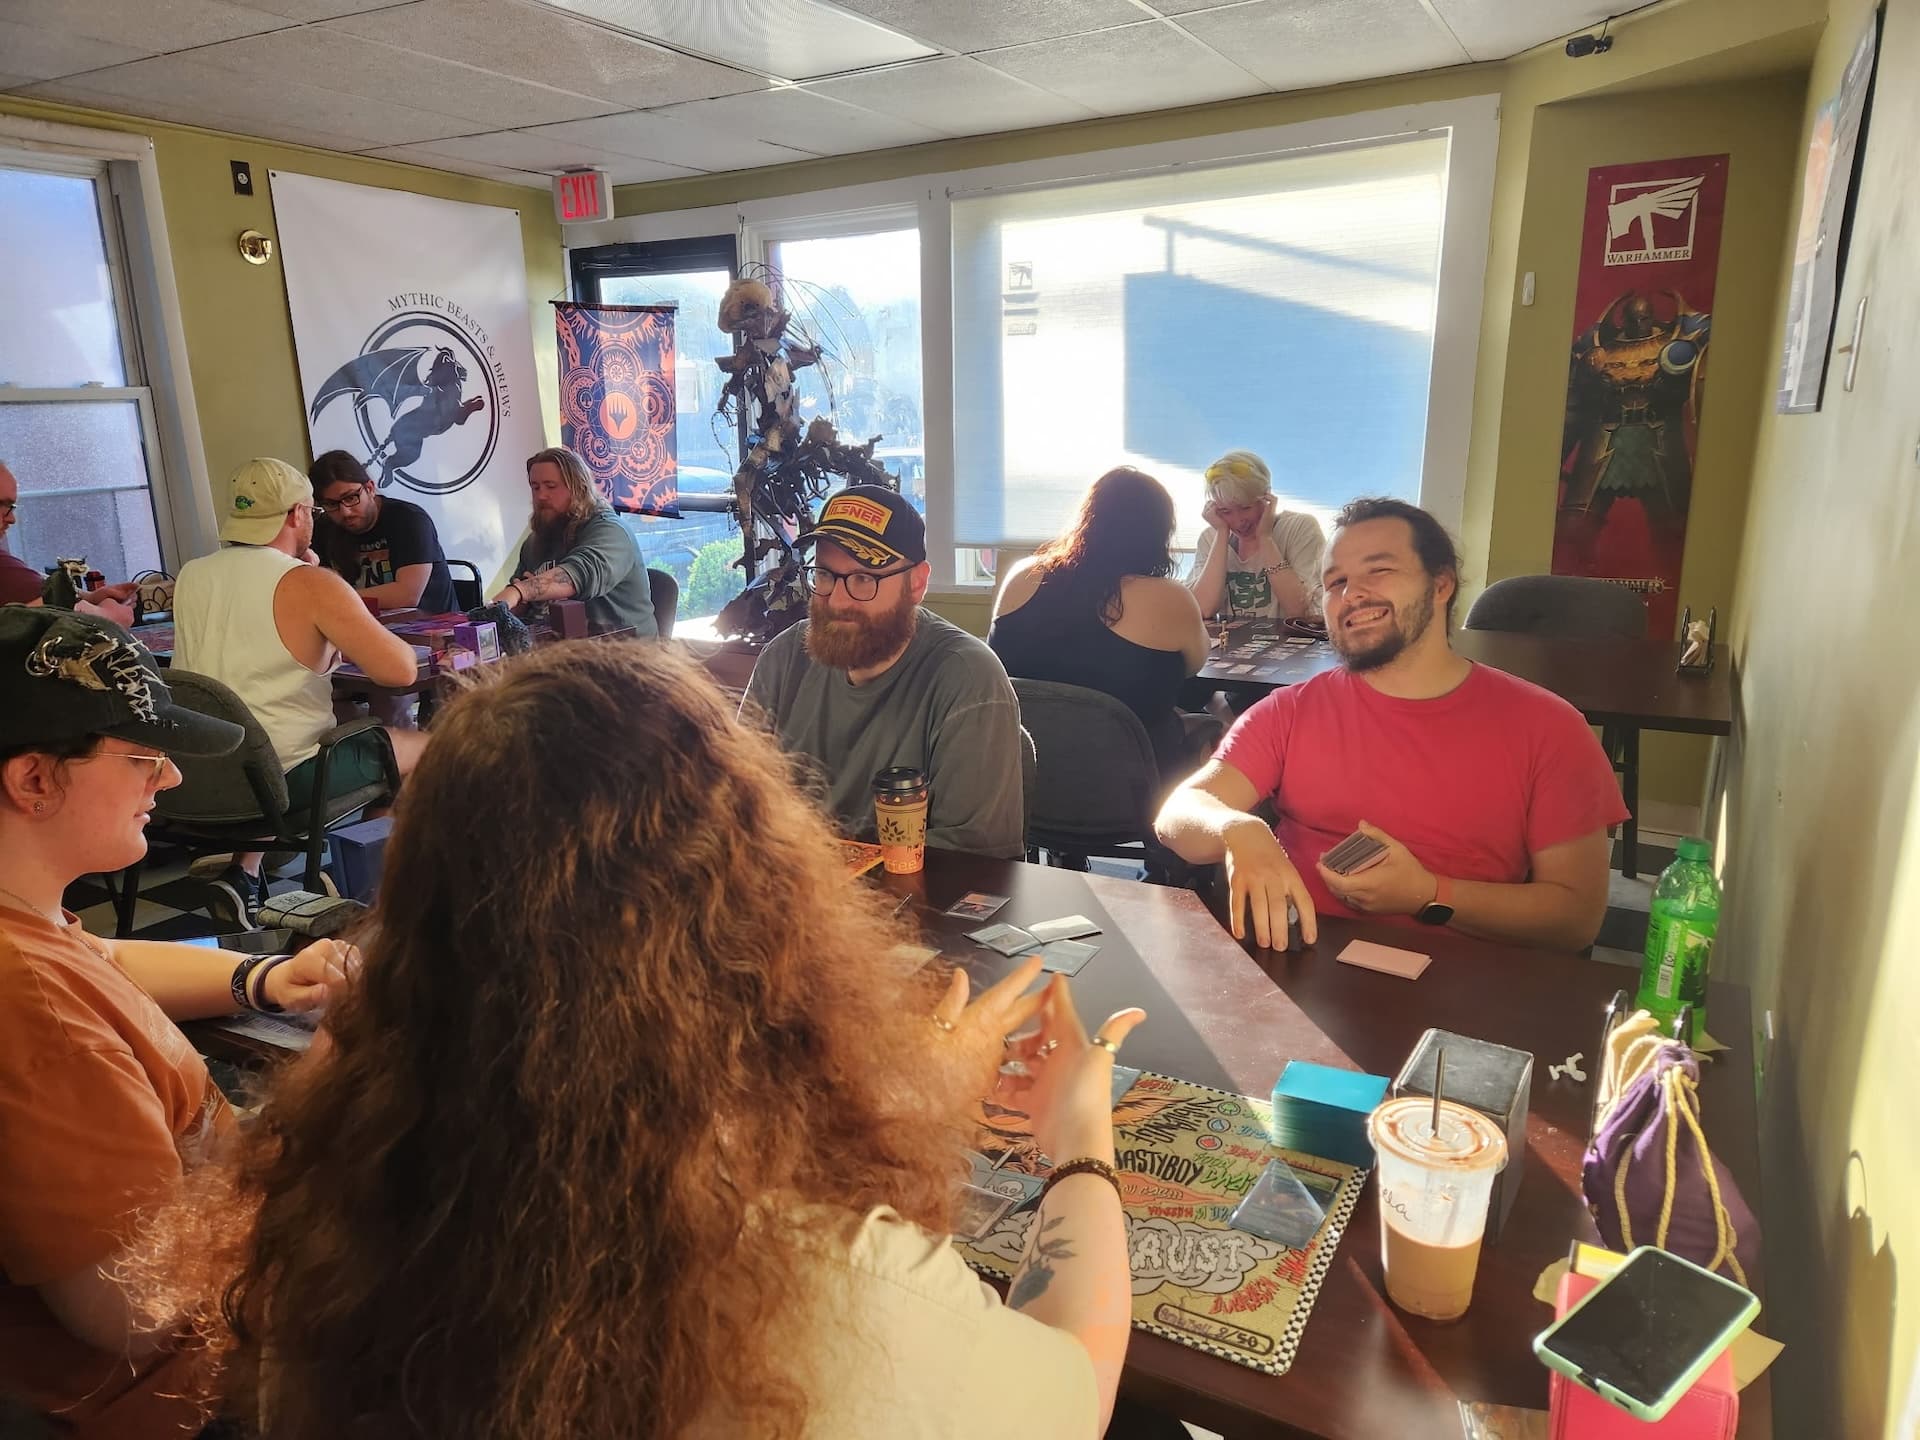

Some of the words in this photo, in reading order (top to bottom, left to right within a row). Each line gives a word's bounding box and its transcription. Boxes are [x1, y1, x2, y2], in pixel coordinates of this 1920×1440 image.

[560, 172, 599, 219] EXIT
[1607, 249, 1690, 263] WARHAMMER
[388, 292, 444, 312] MYTHIC
[447, 300, 489, 345] BEASTS
[486, 345, 497, 358] &
[493, 361, 512, 418] BREWS
